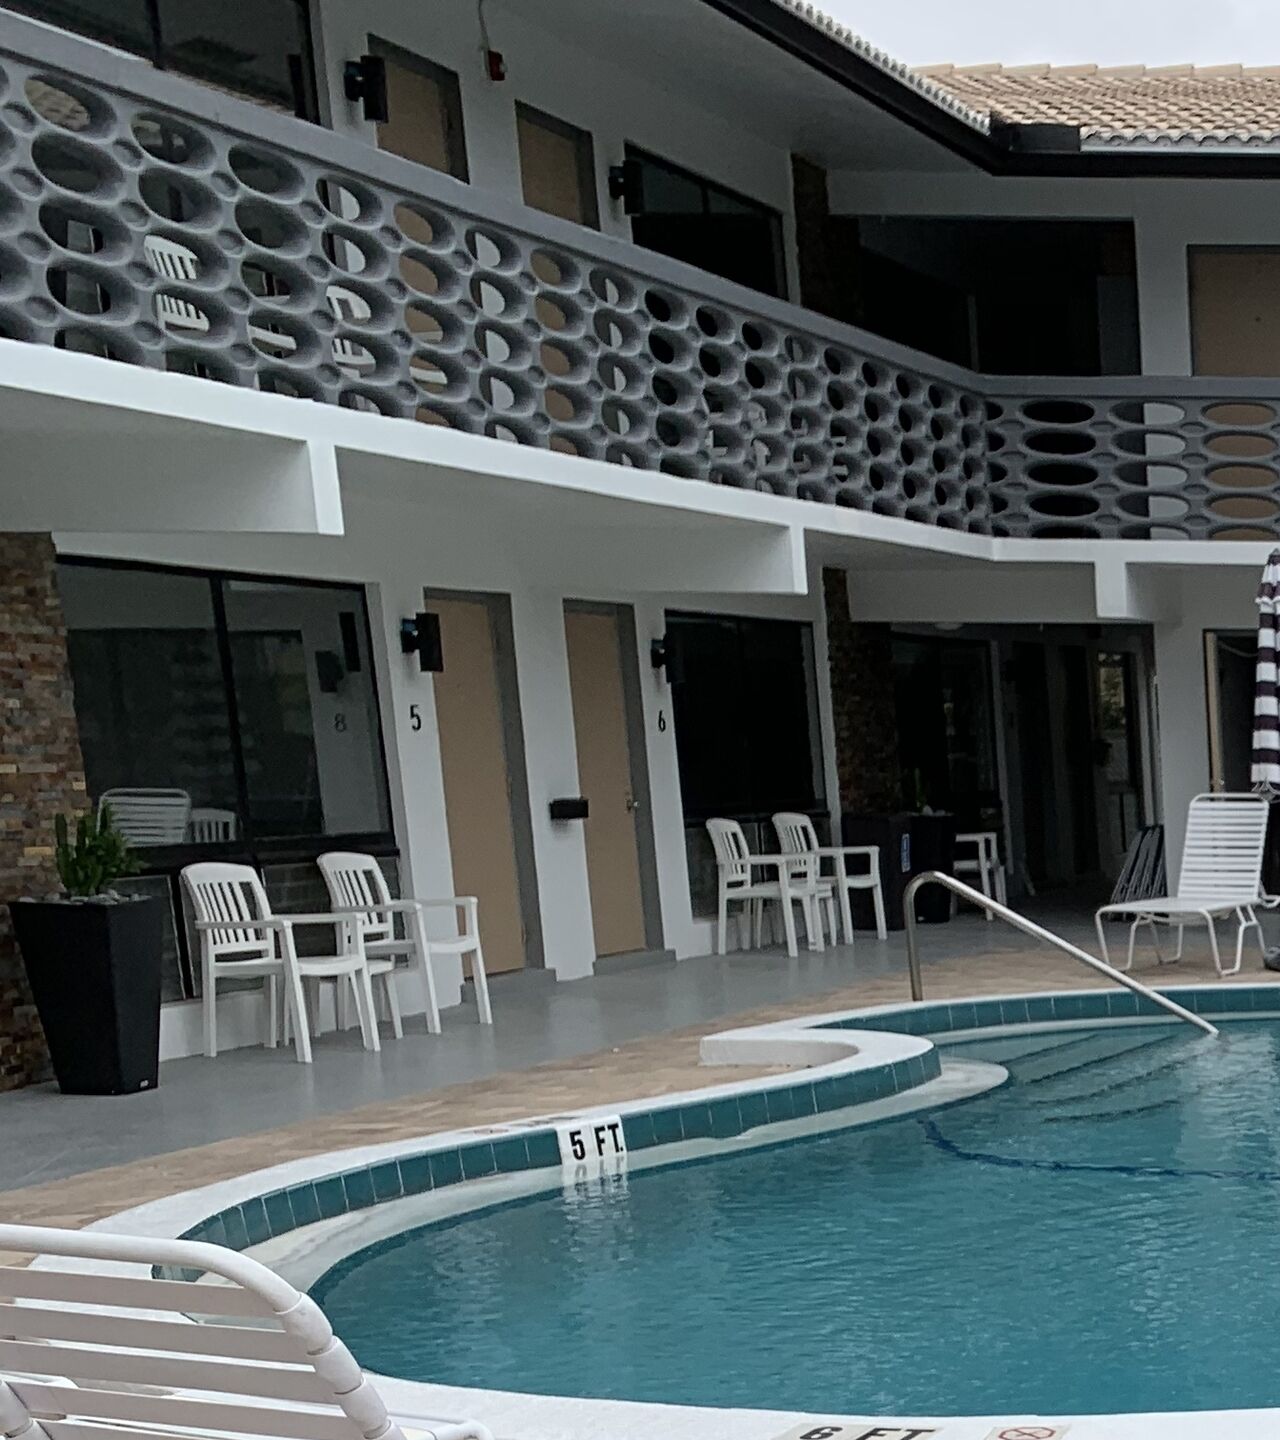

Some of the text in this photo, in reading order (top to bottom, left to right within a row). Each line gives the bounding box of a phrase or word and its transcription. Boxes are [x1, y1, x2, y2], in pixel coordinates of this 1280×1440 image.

[409, 704, 422, 731] 5
[658, 709, 666, 733] 6
[569, 1122, 624, 1160] 5 FT.
[799, 1426, 843, 1440] 6
